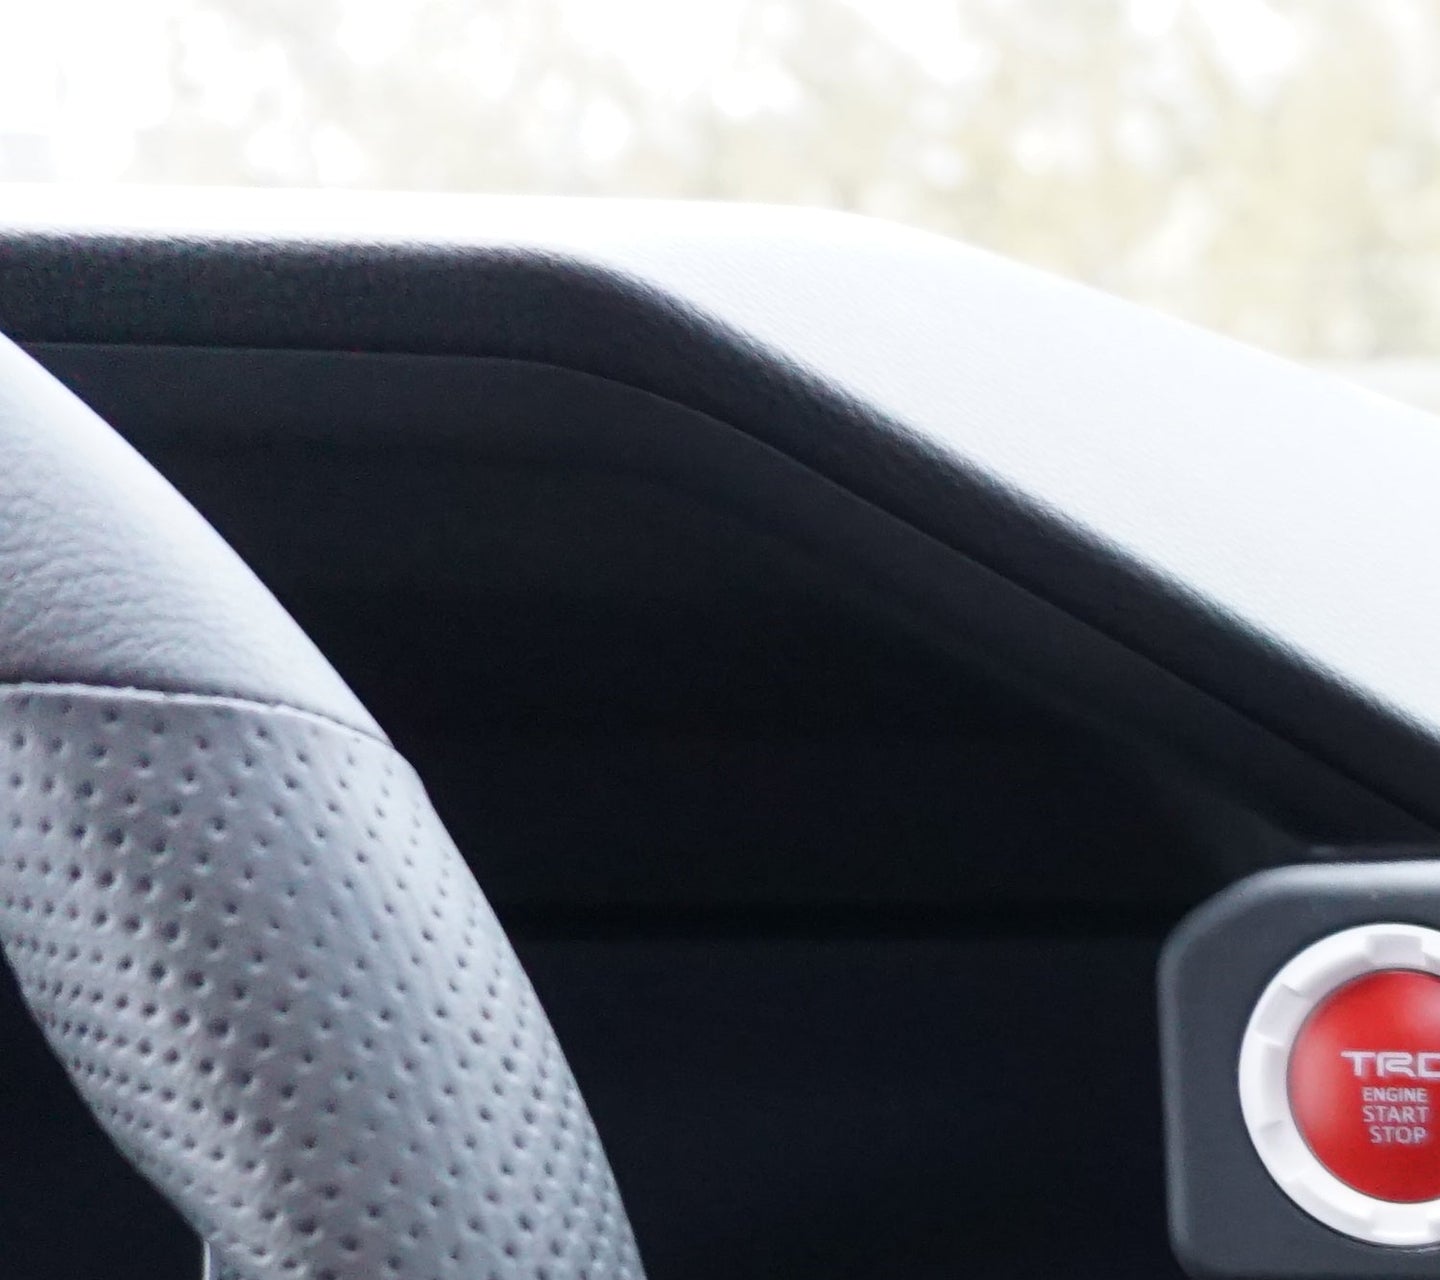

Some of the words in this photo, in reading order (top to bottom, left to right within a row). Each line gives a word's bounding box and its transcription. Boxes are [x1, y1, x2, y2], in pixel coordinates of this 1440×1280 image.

[1362, 1087, 1429, 1103] ENGINE
[1362, 1105, 1430, 1124] START
[1369, 1125, 1428, 1144] STOP
